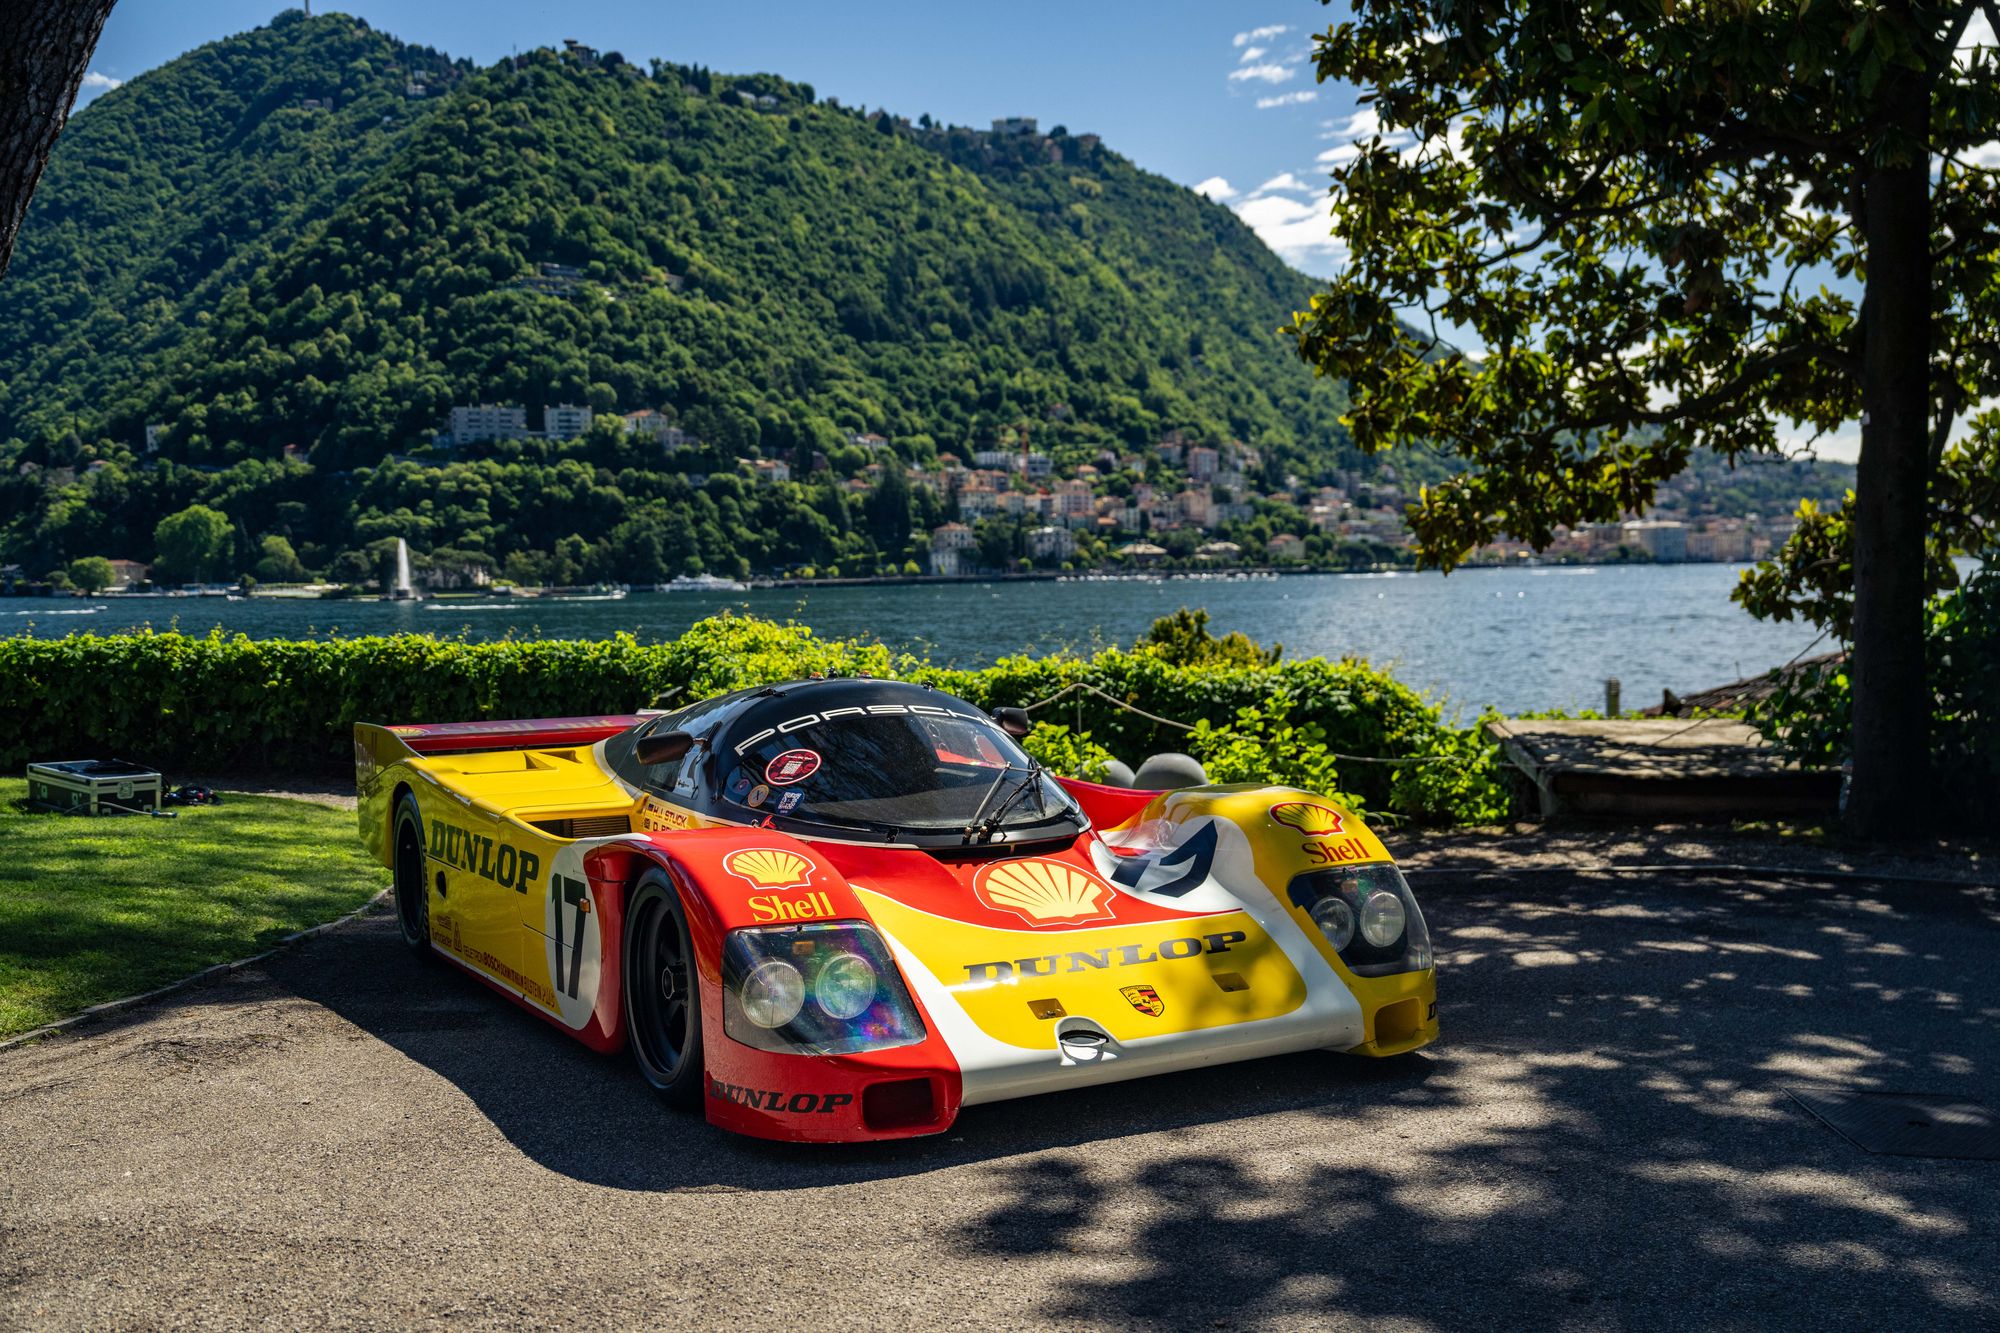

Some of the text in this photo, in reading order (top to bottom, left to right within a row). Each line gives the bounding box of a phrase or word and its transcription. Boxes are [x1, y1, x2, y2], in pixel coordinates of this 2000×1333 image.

[734, 704, 1002, 756] PORSCH
[664, 810, 688, 828] STUCK
[430, 818, 540, 895] DUNLOP
[1302, 838, 1371, 864] Shell
[747, 891, 837, 923] Shell
[552, 872, 587, 1000] 17
[963, 930, 1247, 985] DUNLOP
[709, 1080, 853, 1114] DUNLOP
